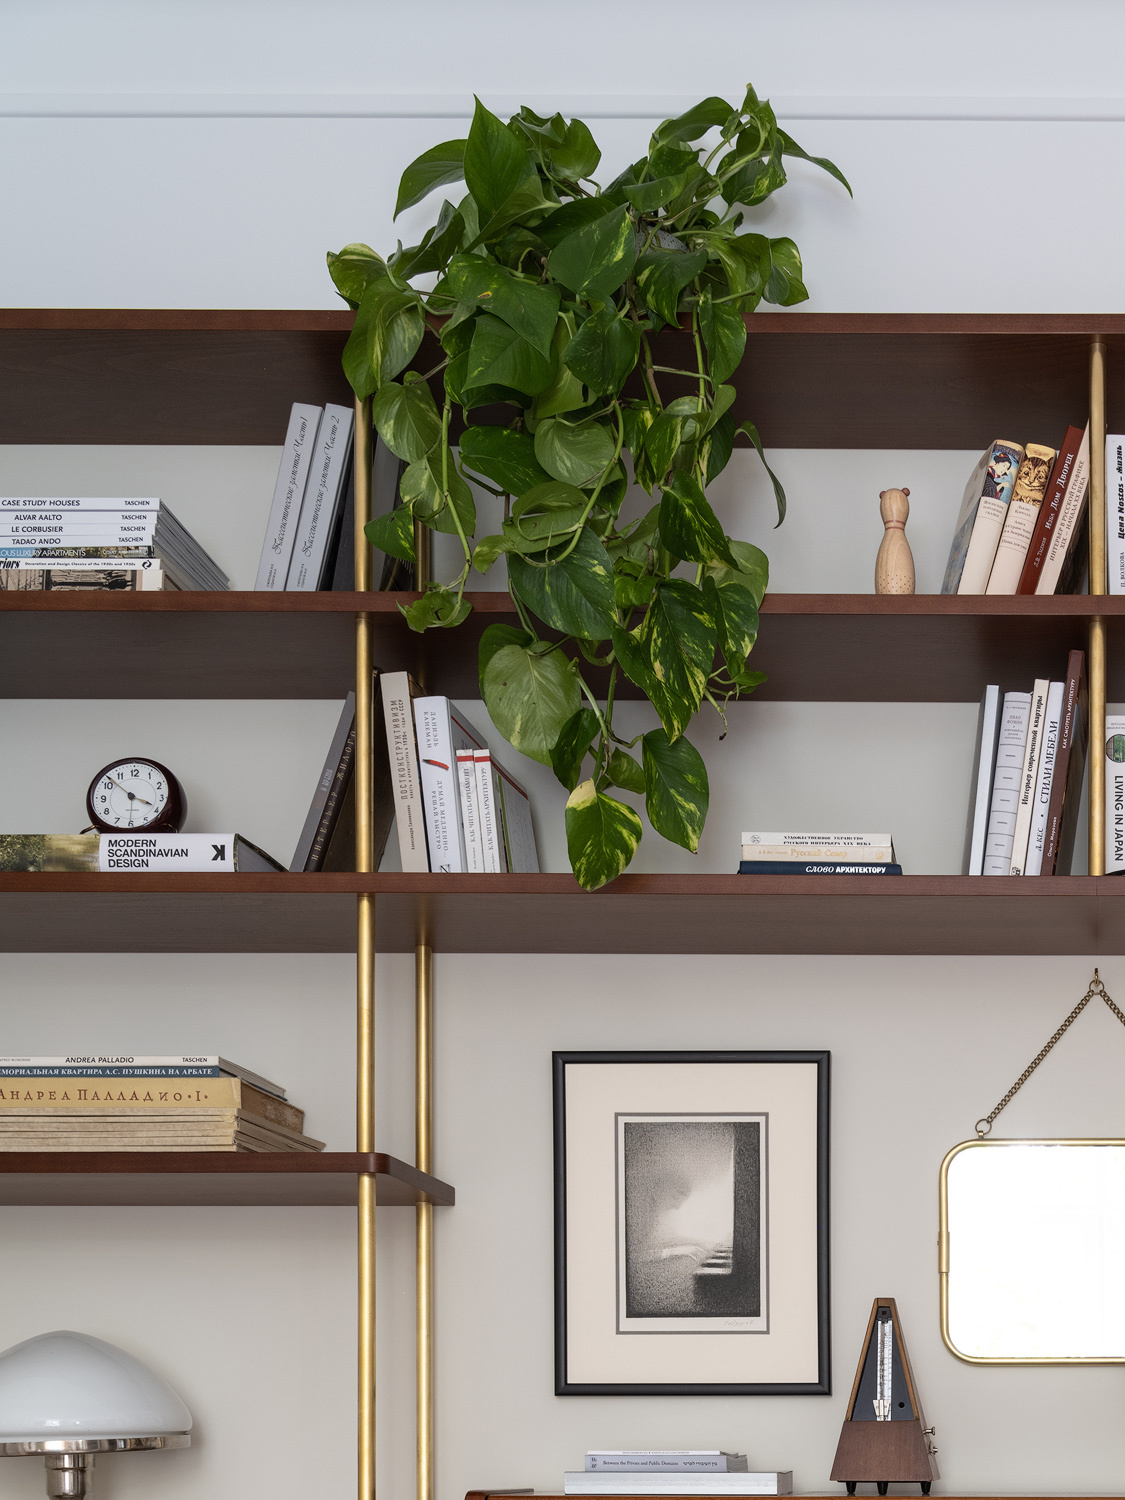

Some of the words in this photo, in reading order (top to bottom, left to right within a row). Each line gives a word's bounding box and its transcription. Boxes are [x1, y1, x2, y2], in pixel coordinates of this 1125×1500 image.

[1050, 492, 1061, 510] Дом
[1056, 453, 1074, 488] Дворец
[1032, 695, 1043, 728] квартиры
[1063, 713, 1071, 737] СМОТРЕТЬ
[1067, 679, 1075, 711] АРХИТЕКТУРУ
[424, 711, 432, 748] КАНЕМАН
[430, 711, 439, 747] ДАНИЭЛЬ
[1046, 720, 1058, 766] МЕБЕЛИ
[390, 699, 408, 800] ПОСТКОНСТРУКТИВИЗМ
[1026, 730, 1038, 772] современной
[104, 782, 113, 790] 10
[117, 772, 123, 780] 11
[131, 769, 139, 777] 12
[156, 782, 162, 790] 2
[1040, 767, 1053, 804] СТИЛИ
[101, 795, 106, 803] 9
[436, 780, 445, 807] ДУМАЙ
[1021, 774, 1032, 805] Интерьер
[1114, 775, 1123, 811] LIVING
[311, 791, 338, 861] ИНТЕРЬЕР
[1114, 814, 1123, 824] IN
[433, 820, 441, 850] БЫСТРО
[1036, 827, 1044, 843] КЕС
[1114, 828, 1124, 861] JAPAN
[108, 849, 188, 857] SCANDINAVIAN
[108, 859, 149, 868] DESIGN
[805, 865, 834, 873] СЛОВО
[835, 866, 886, 874] АРХИТЕКТОРУ
[77, 1089, 183, 1102] ПАЛЛАДИО
